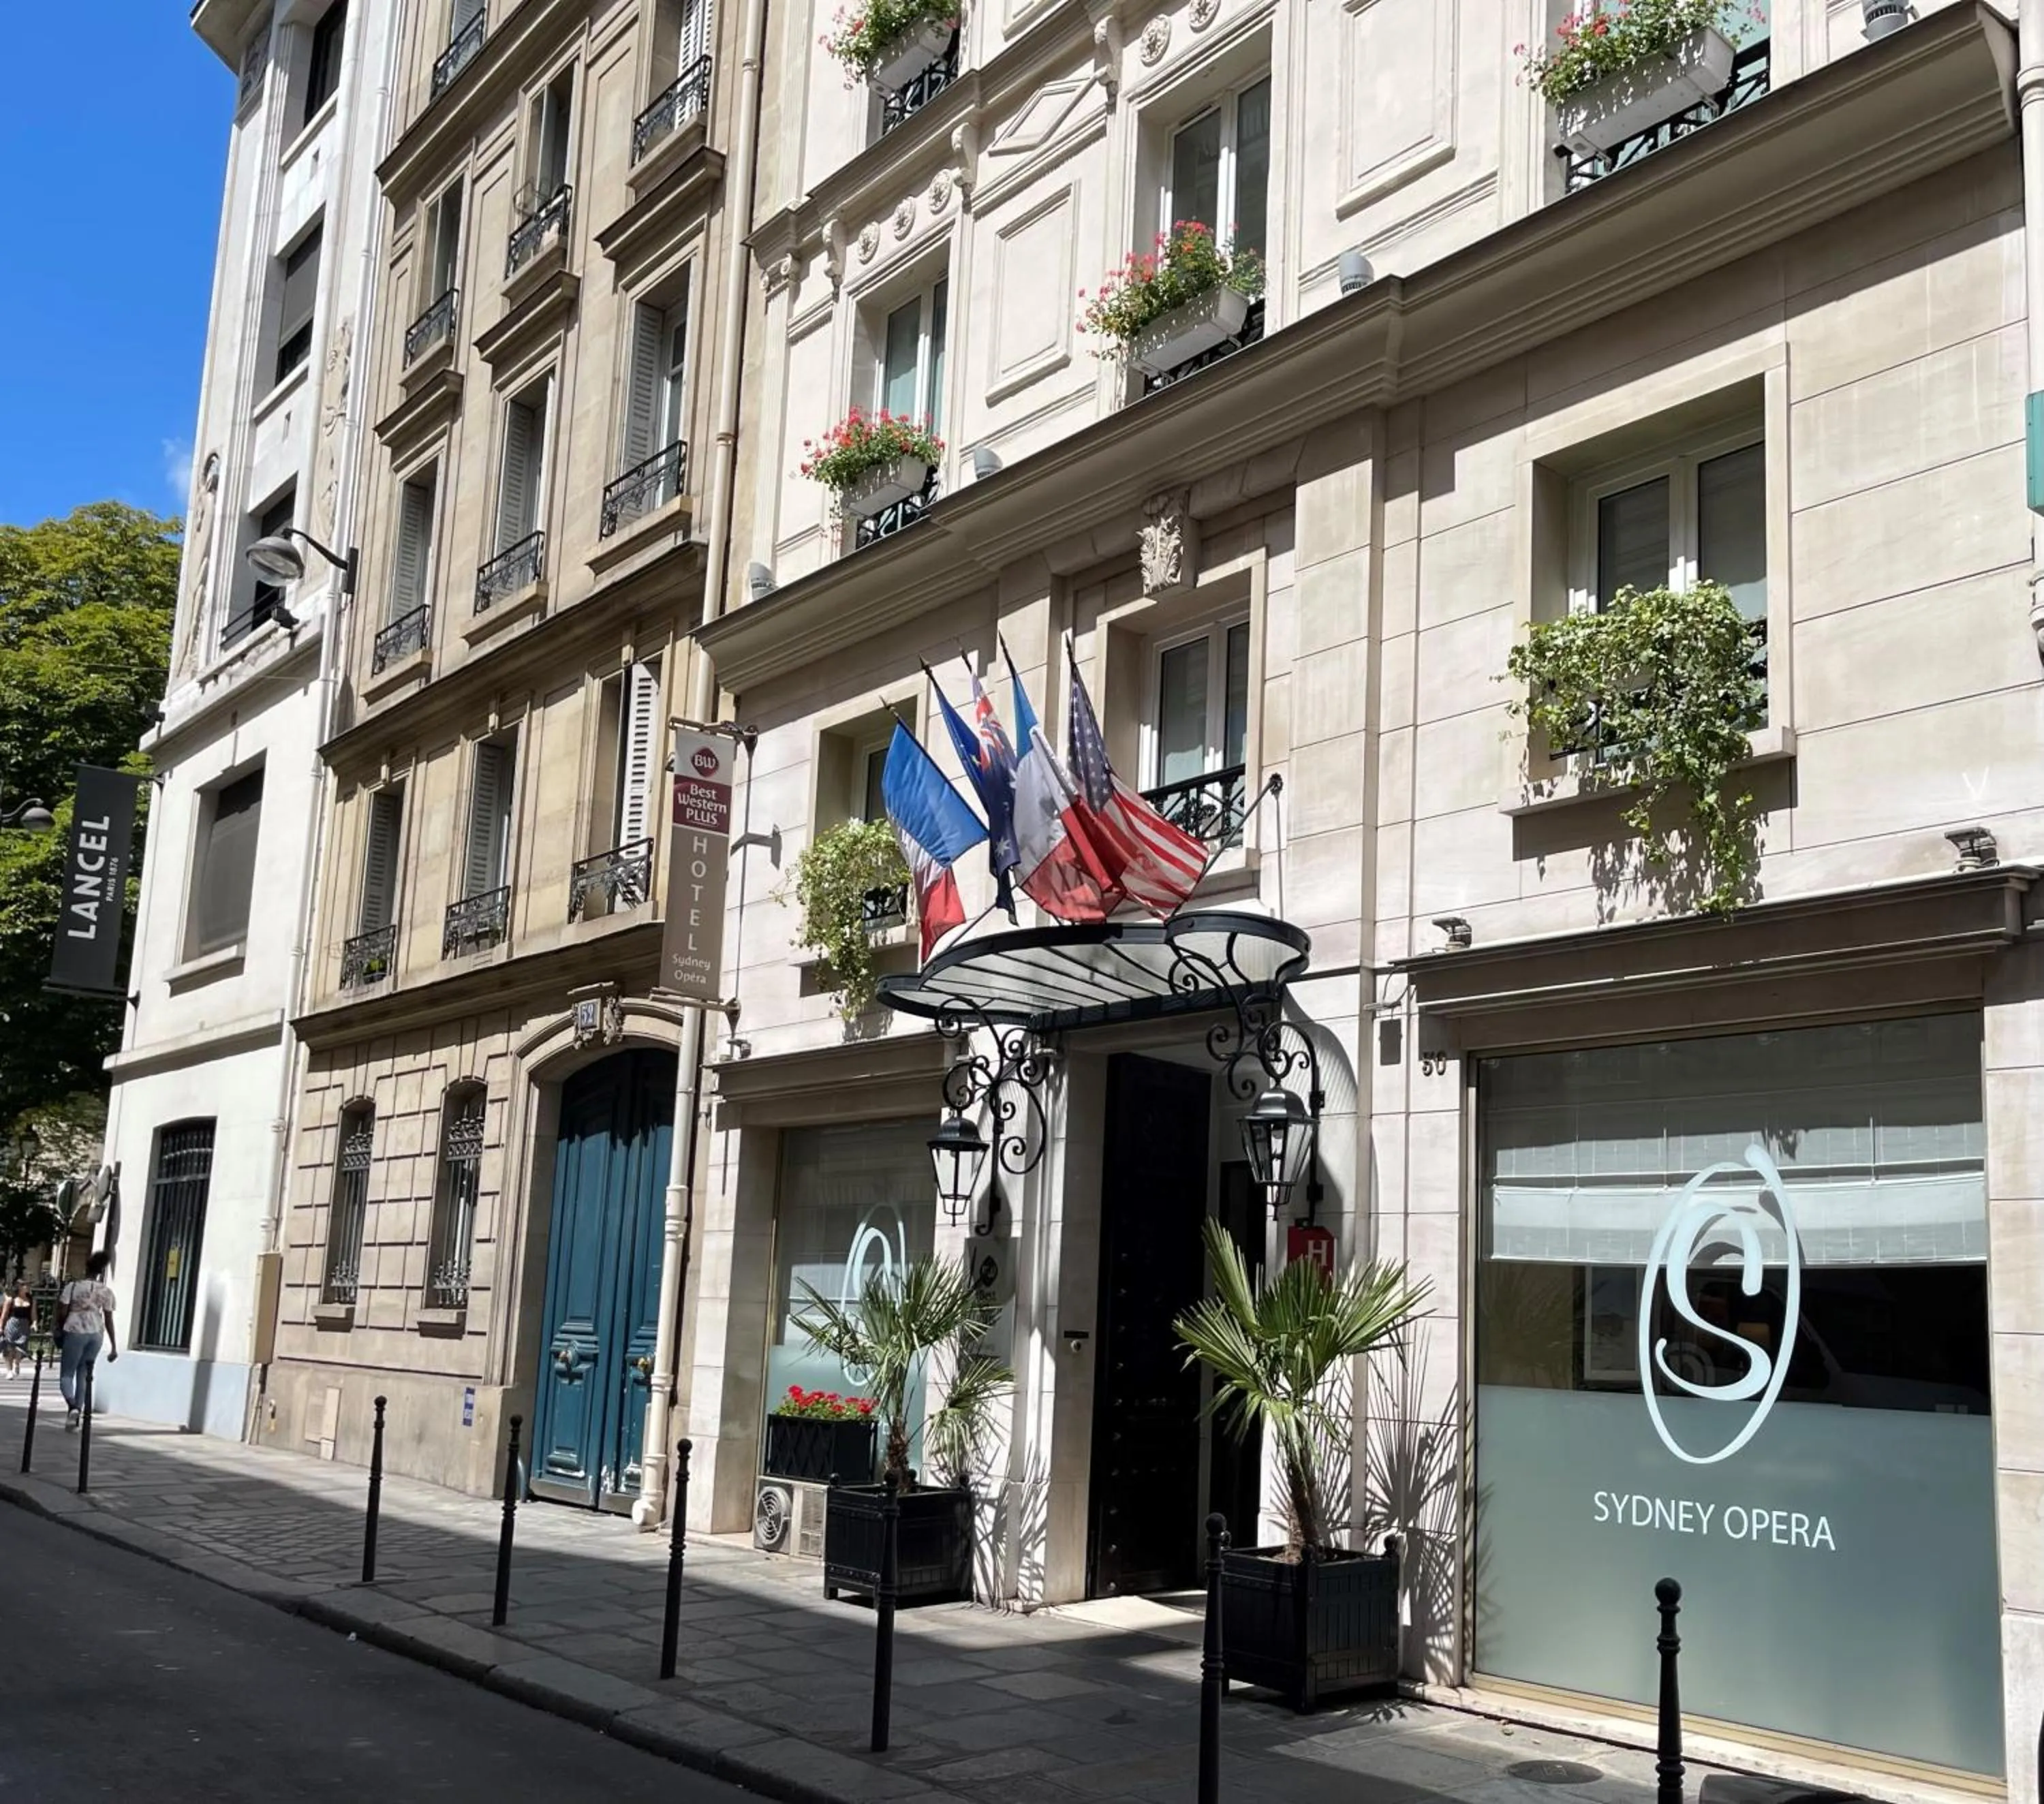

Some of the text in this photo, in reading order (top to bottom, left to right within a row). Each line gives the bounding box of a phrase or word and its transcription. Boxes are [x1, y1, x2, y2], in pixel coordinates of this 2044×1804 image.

[695, 754, 716, 769] BW
[677, 792, 727, 814] Western
[690, 784, 717, 800] Best
[686, 807, 718, 825] PLUS
[68, 816, 110, 939] LANCEL
[106, 878, 117, 902] PARIS
[688, 836, 708, 950] HOTEL
[672, 954, 711, 971] Sydney
[1307, 1240, 1329, 1266] H
[1594, 1491, 1836, 1551] SYDNEY OPERA
